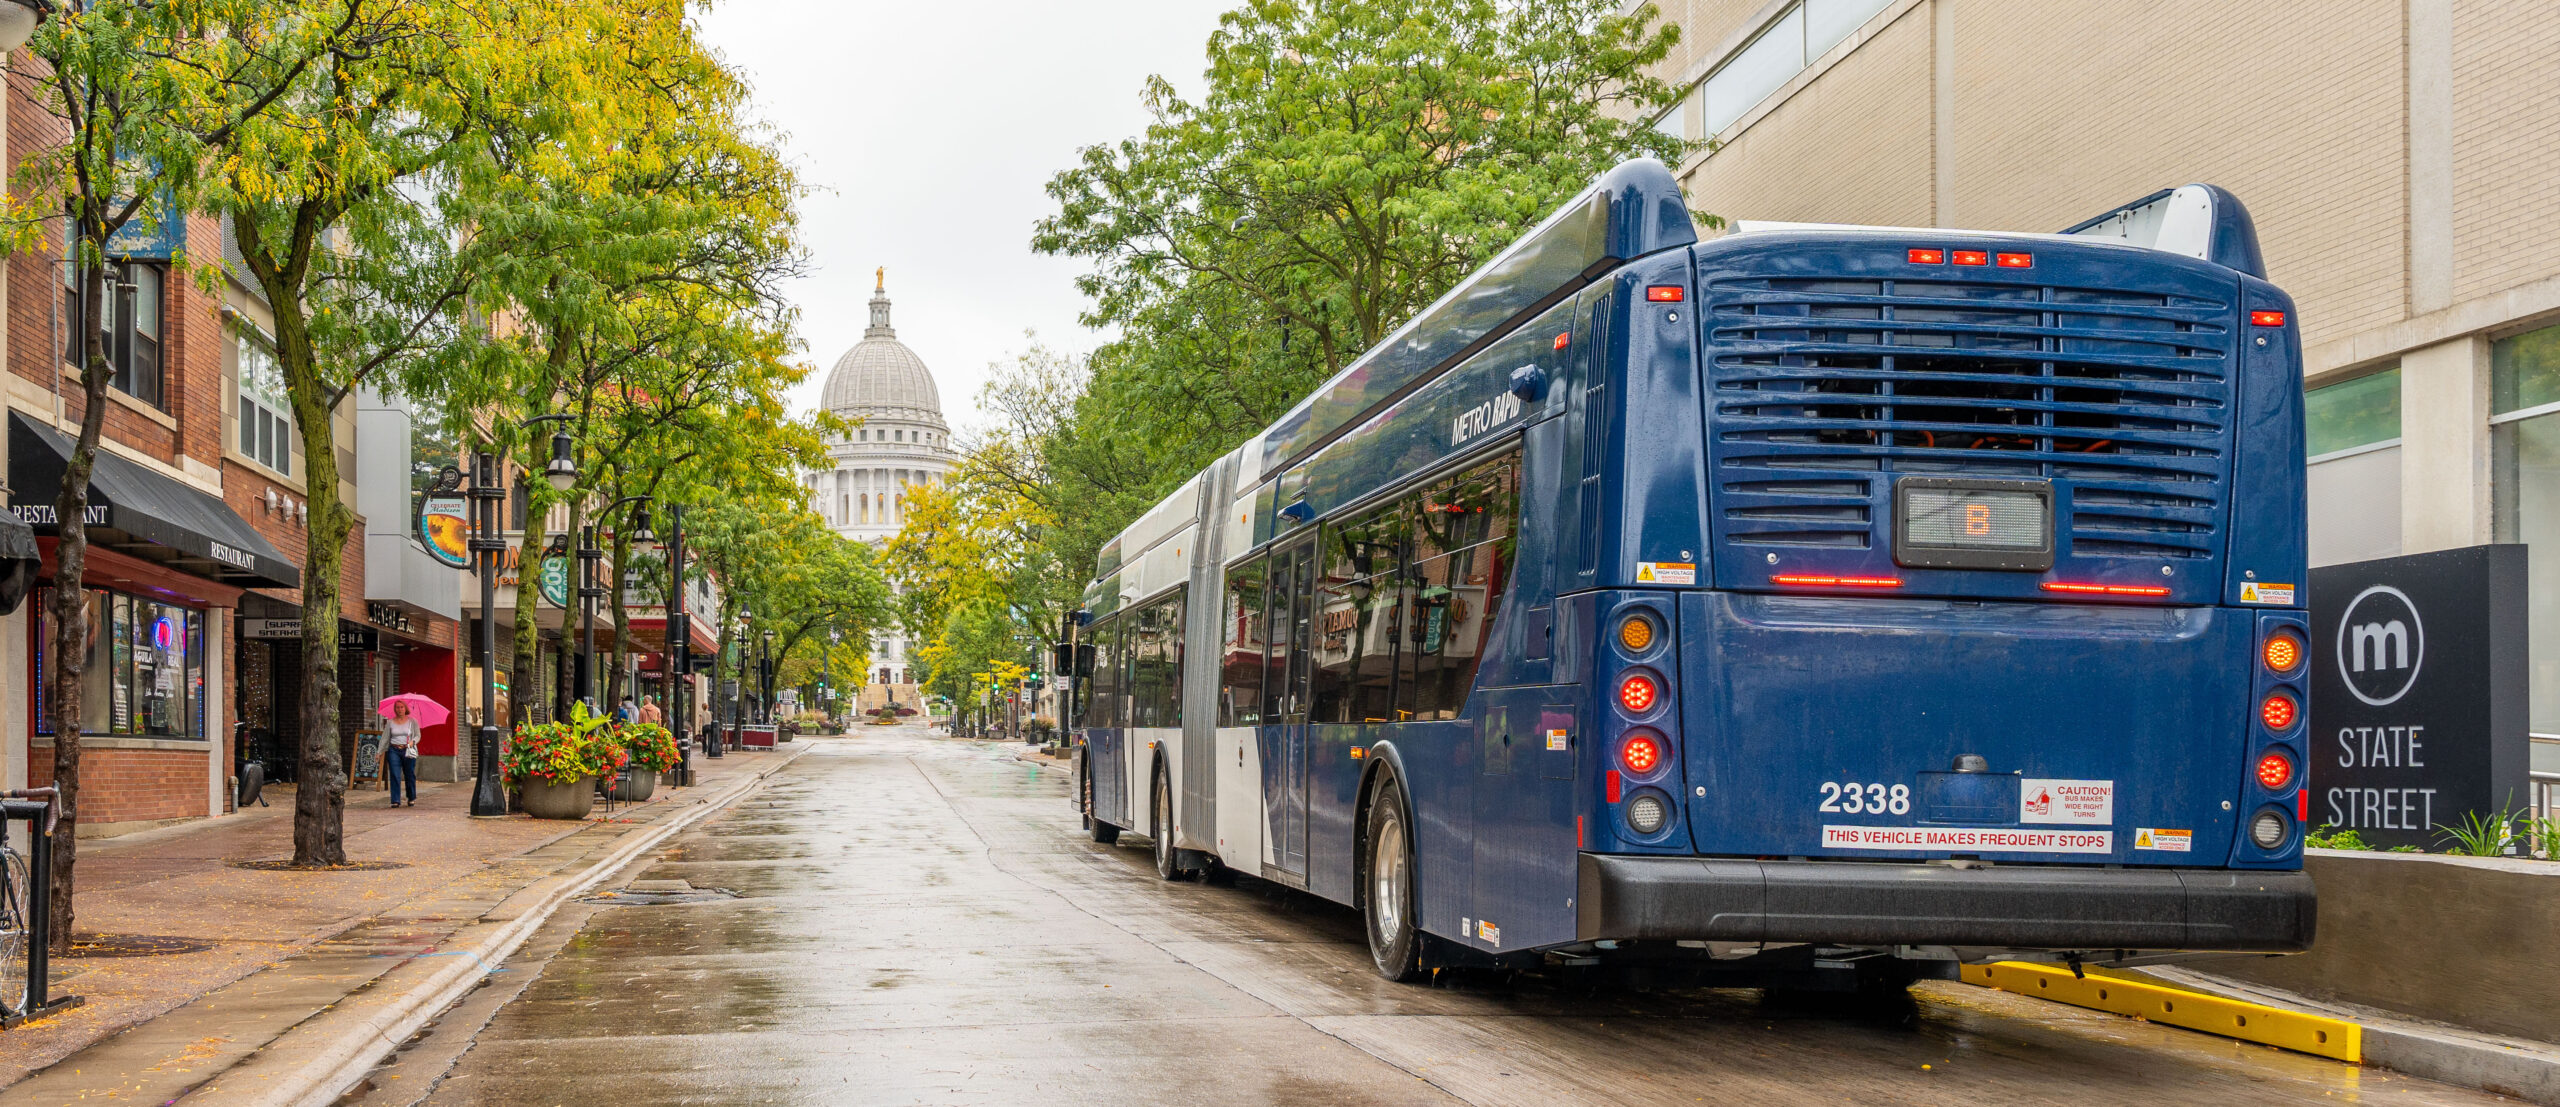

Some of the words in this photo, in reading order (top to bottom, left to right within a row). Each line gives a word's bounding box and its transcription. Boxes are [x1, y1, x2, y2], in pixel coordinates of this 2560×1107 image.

[1451, 401, 1491, 446] METRO
[1491, 389, 1521, 428] RAPID
[1966, 504, 1990, 535] B
[211, 541, 255, 570] RESTAURANT
[545, 558, 562, 599] 200
[258, 629, 301, 637] SNEAKE
[339, 631, 364, 644] CHA
[2352, 620, 2408, 672] m
[2338, 725, 2424, 768] STATE
[1819, 781, 1911, 815] 2338
[2057, 786, 2111, 796] CAUTION!
[2327, 787, 2437, 830] STREET
[1828, 830, 1859, 843] THIS
[1863, 831, 1922, 844] VEHICLE
[1926, 832, 1976, 845] MAKES
[1979, 834, 2056, 847] FREQUENT
[2058, 835, 2105, 849] STOPS
